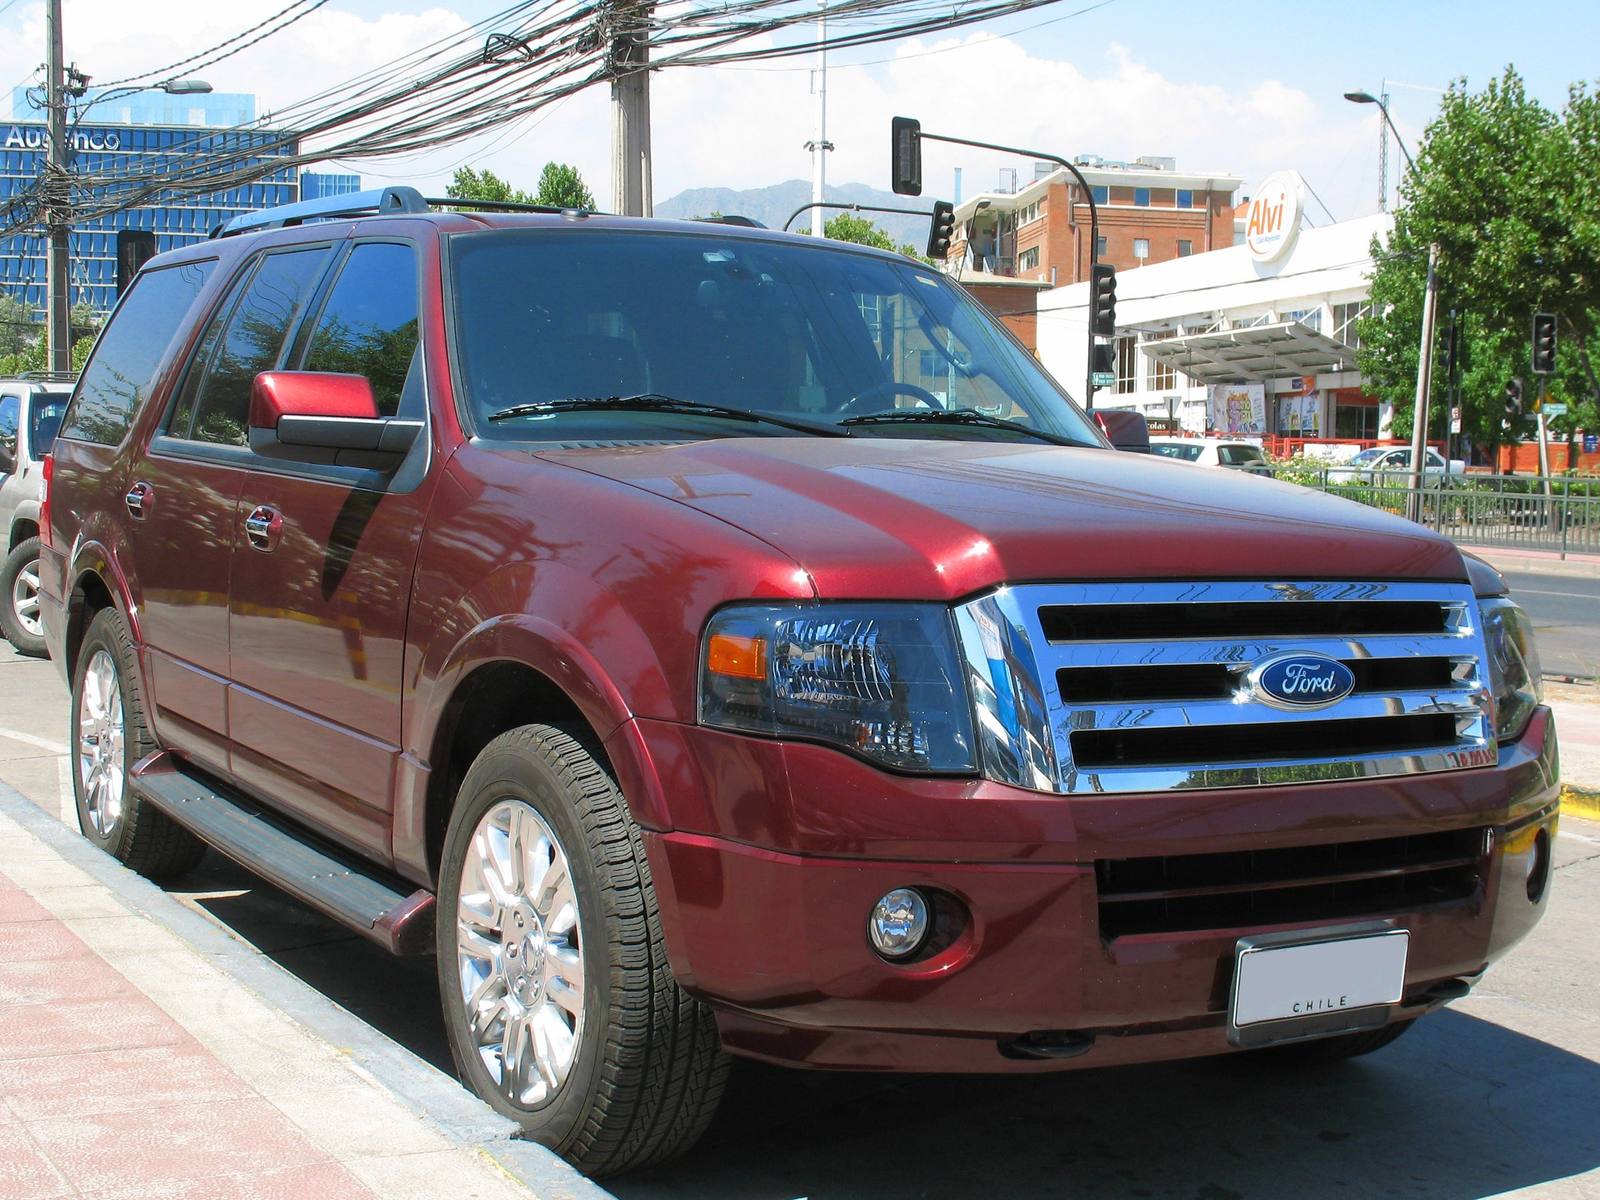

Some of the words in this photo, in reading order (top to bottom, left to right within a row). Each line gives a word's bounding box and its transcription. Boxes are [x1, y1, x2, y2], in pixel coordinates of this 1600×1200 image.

[1247, 193, 1284, 236] Alvi
[1282, 663, 1336, 694] Ford
[1292, 996, 1347, 1013] CHILE
